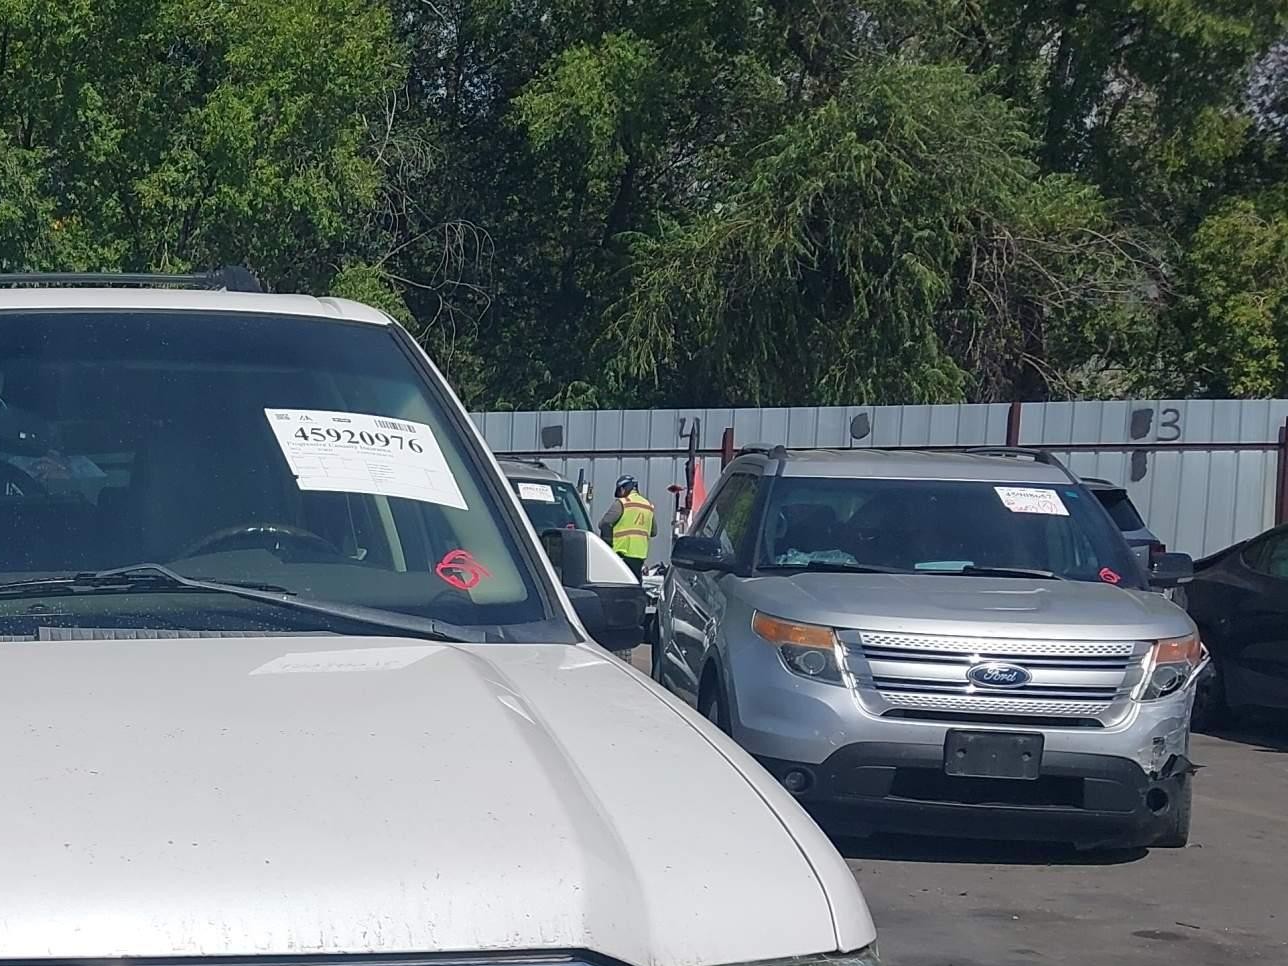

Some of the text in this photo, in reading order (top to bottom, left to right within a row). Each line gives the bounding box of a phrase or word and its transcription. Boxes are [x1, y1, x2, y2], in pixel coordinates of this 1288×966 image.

[1157, 408, 1181, 442] 3
[294, 426, 423, 454] 45920976
[983, 667, 1018, 682] Ford
